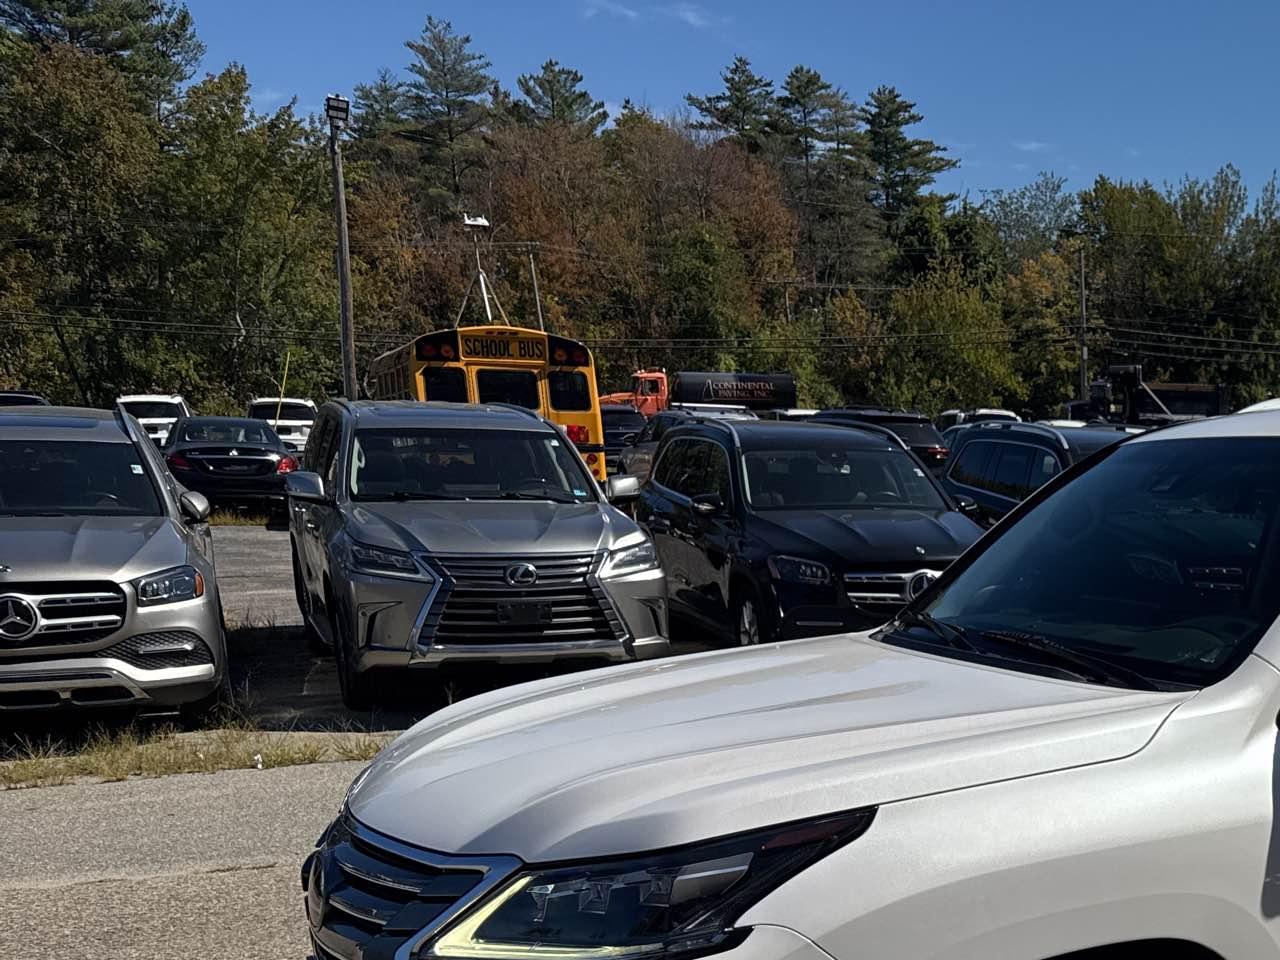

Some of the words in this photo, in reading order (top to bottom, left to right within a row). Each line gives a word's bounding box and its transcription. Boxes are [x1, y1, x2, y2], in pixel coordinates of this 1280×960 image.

[464, 338, 513, 357] SCHOOL
[519, 340, 543, 358] BUS
[713, 382, 775, 390] CONTINENTAL
